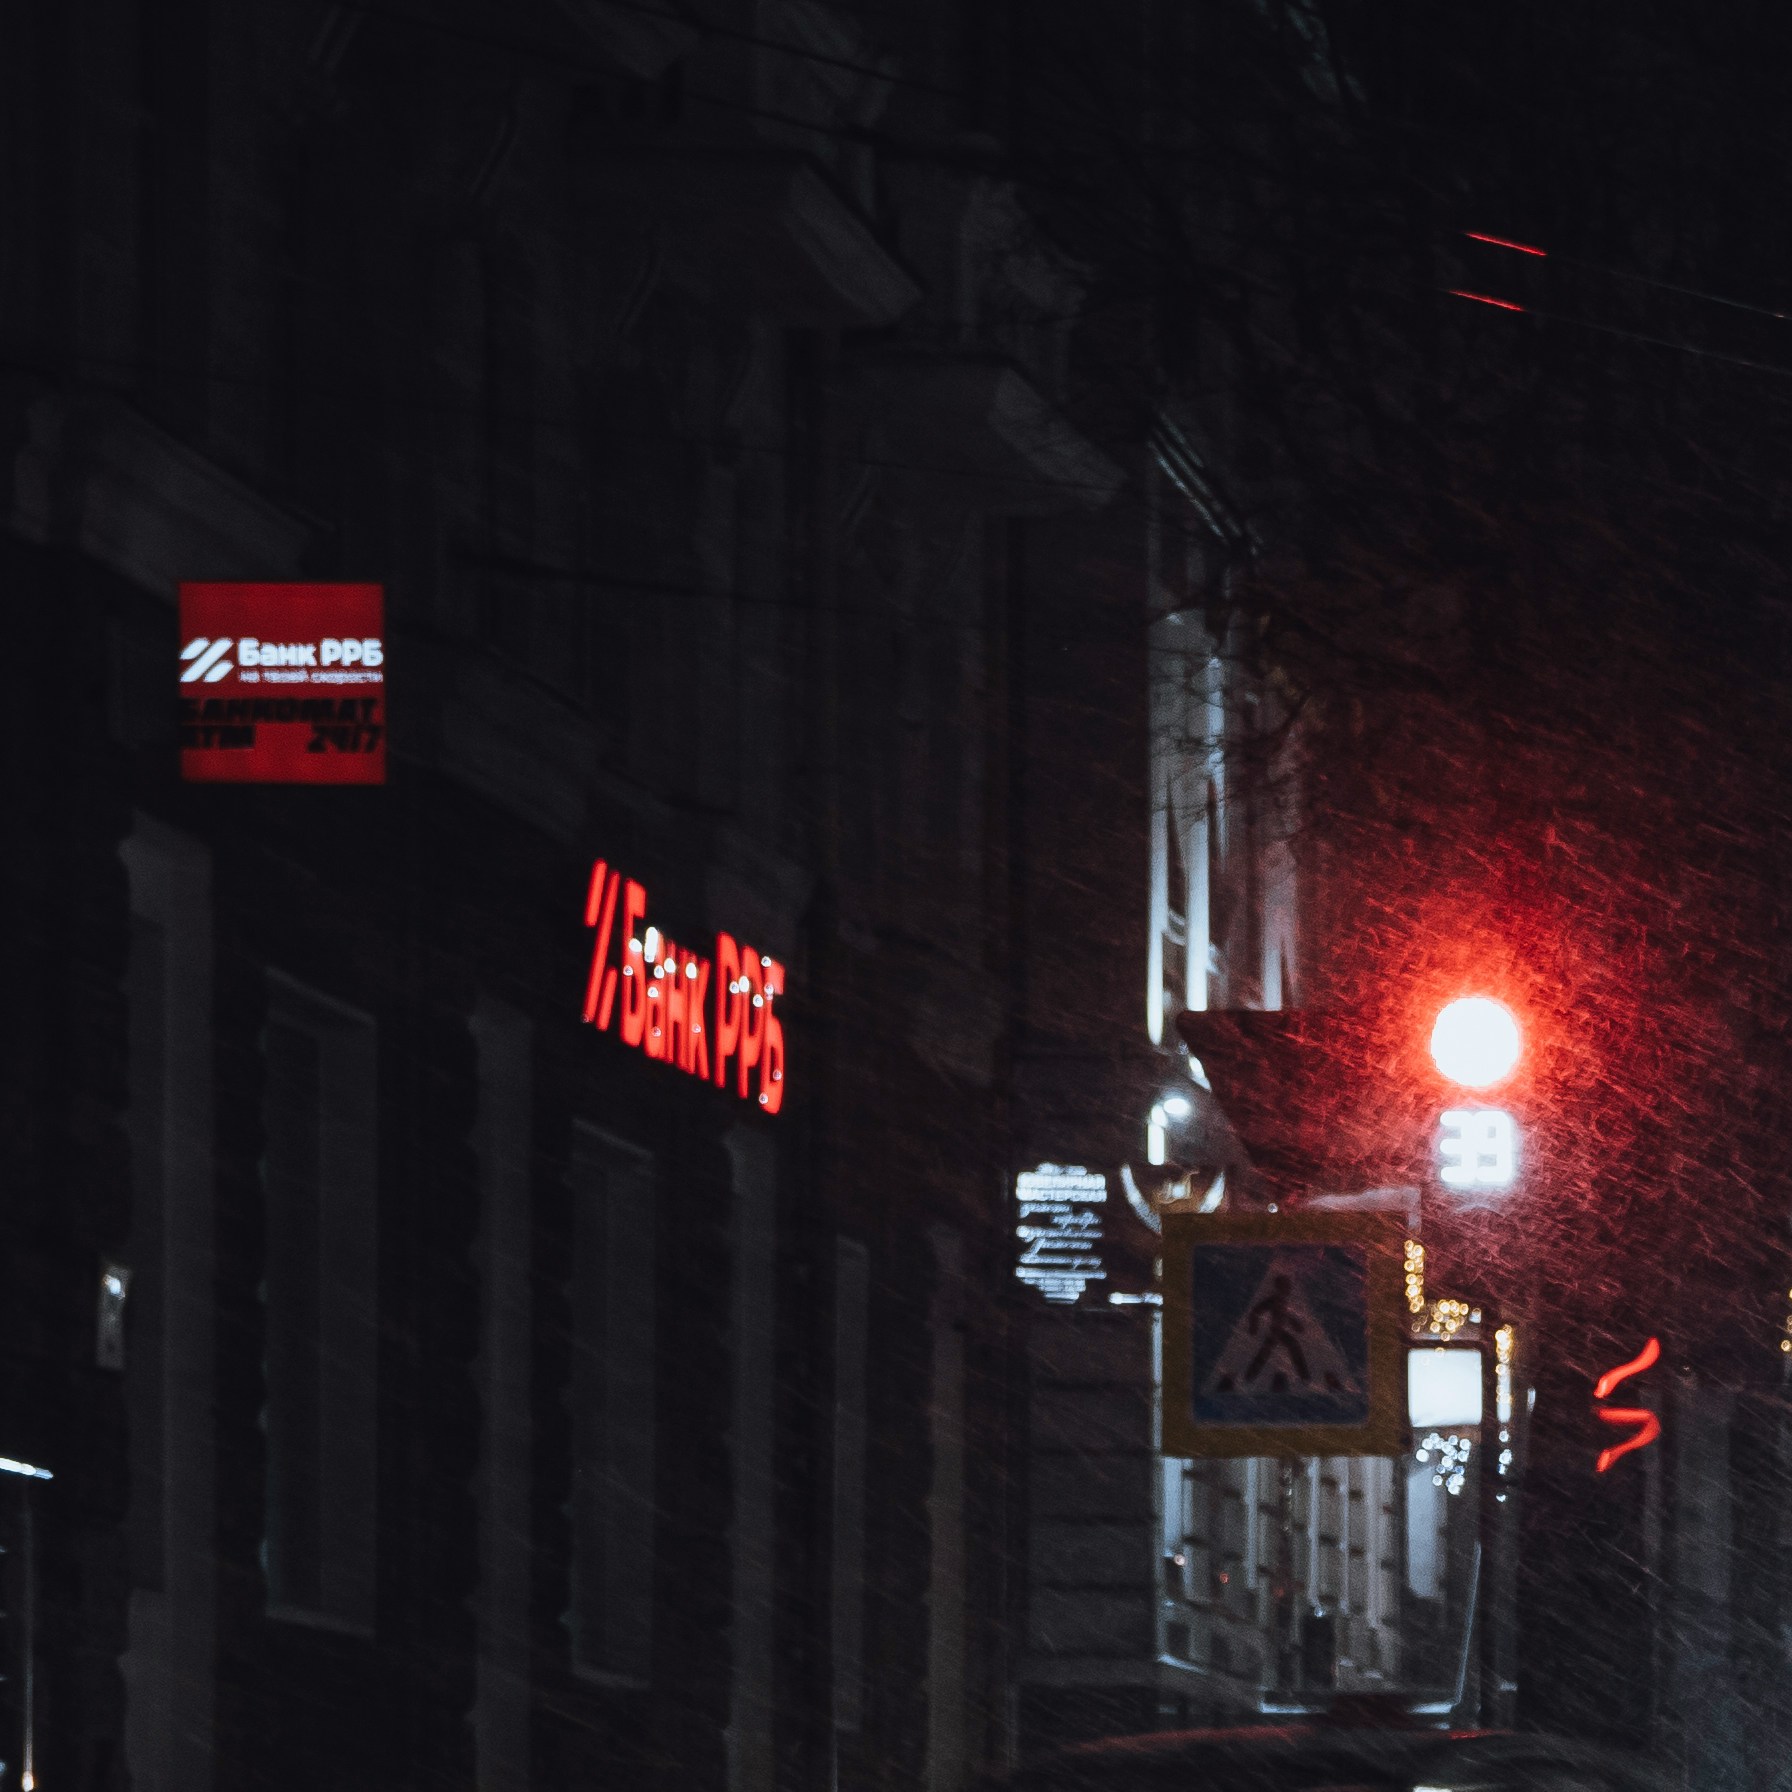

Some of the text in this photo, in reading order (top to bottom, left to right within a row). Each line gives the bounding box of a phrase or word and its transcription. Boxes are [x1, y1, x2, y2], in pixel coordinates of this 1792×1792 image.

[238, 637, 384, 667] Банк РРБ
[618, 877, 786, 1115] Банк РРБ
[1439, 1110, 1511, 1183] 39
